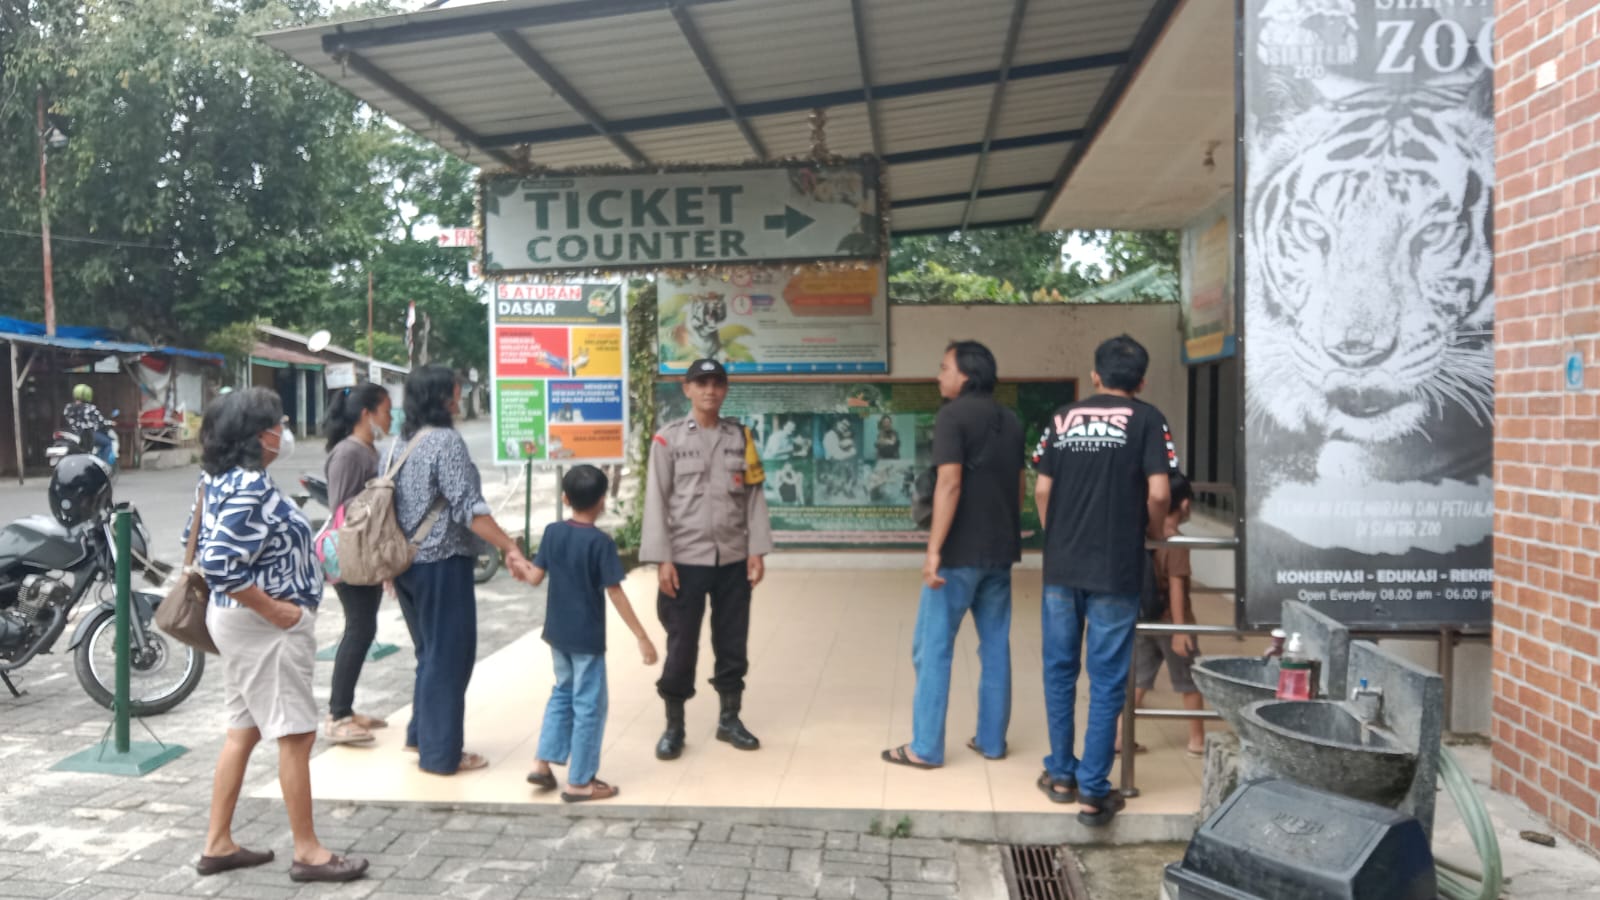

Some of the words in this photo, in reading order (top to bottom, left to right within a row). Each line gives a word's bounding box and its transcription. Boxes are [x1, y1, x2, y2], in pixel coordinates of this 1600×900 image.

[1294, 65, 1325, 79] ZOO
[524, 184, 744, 231] TICKET
[526, 229, 749, 264] COUNTER
[499, 283, 509, 299] 5
[513, 285, 581, 300] ATURAN
[499, 301, 556, 315] DASAR
[1054, 407, 1134, 440] VANS
[1415, 500, 1439, 517] DAN
[1418, 519, 1442, 537] ZOO
[1276, 569, 1365, 584] KONSERVASI
[1376, 568, 1437, 583] EDUKASI
[1298, 588, 1326, 603] Open
[1330, 588, 1376, 602] Everyday
[1380, 588, 1412, 600] 08.00
[1416, 590, 1432, 600] am
[1445, 588, 1478, 600] 06.00
